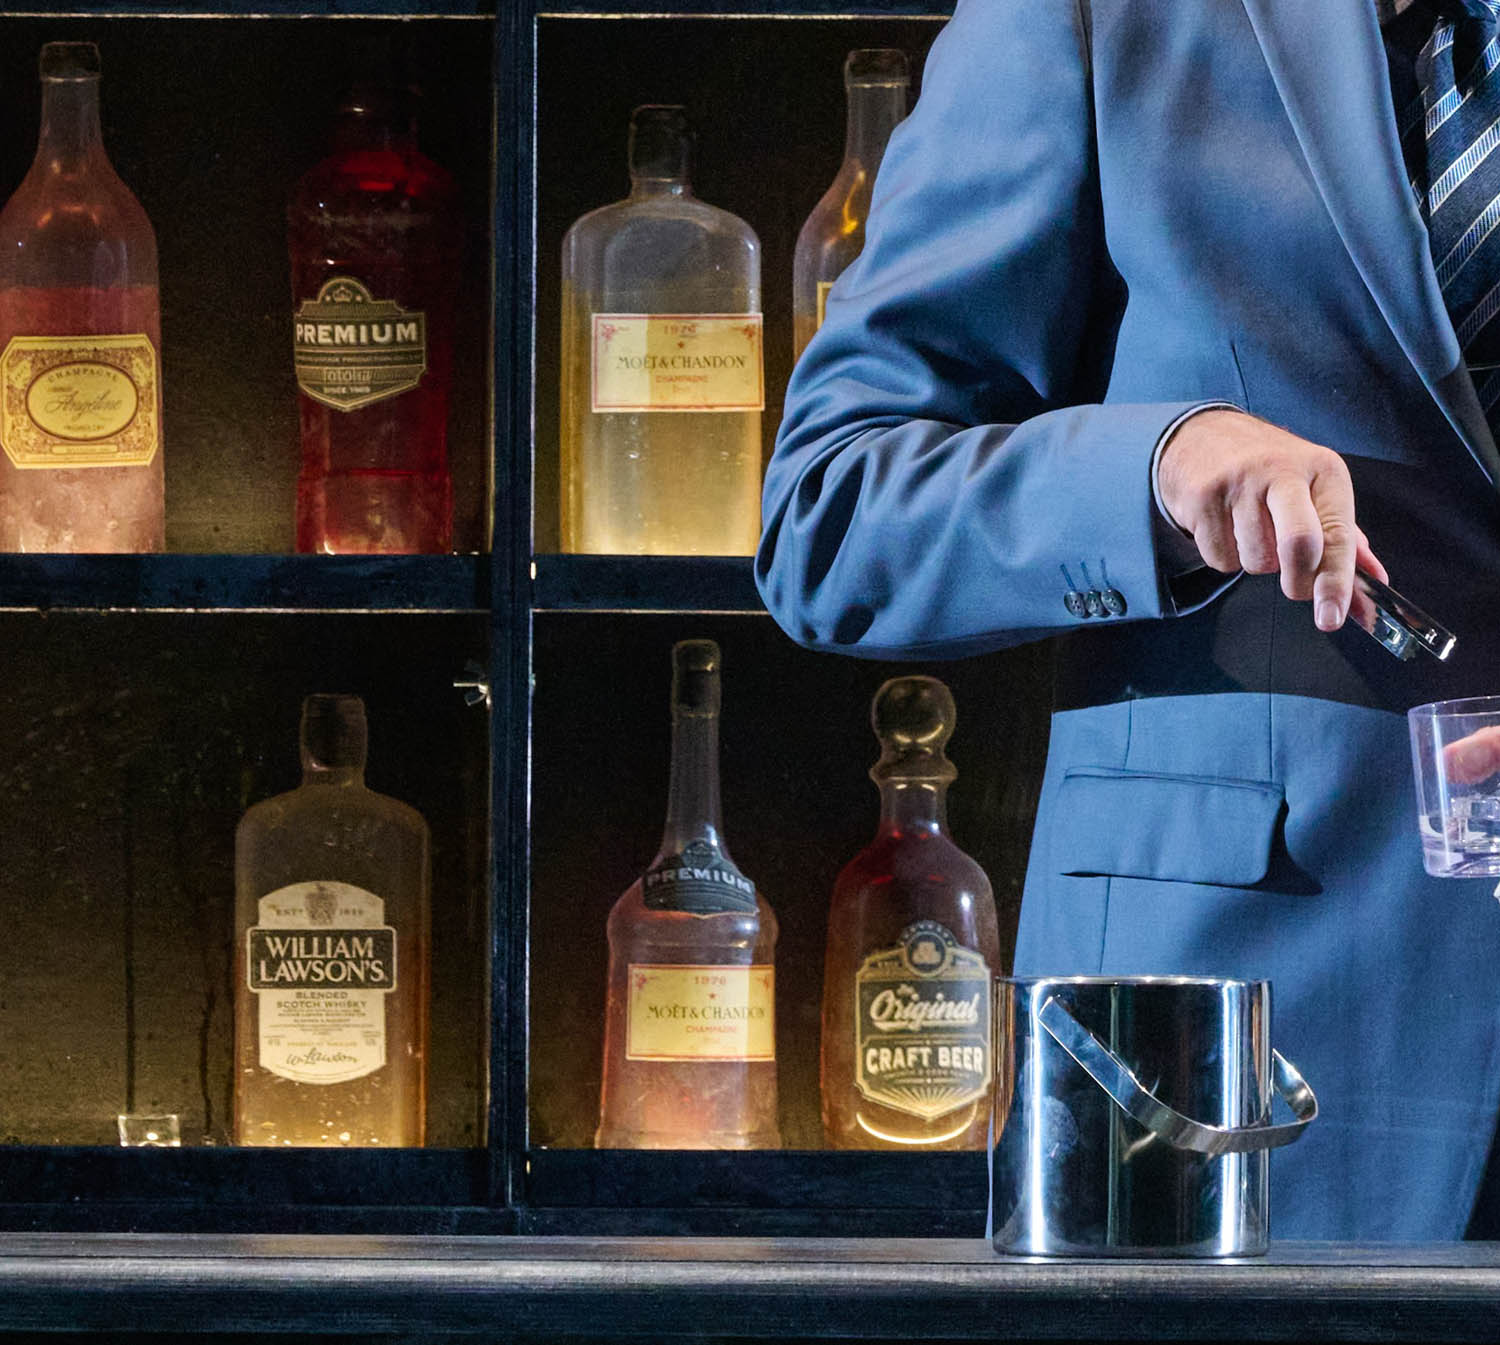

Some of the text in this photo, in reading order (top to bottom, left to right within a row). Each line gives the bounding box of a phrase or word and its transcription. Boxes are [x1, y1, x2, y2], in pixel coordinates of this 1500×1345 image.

[296, 323, 418, 345] PREMIUM
[671, 355, 746, 369] CHANDON
[48, 368, 118, 382] CHAMPAGNE
[647, 867, 752, 893] PREMIUM
[265, 936, 374, 958] WILLIAM
[260, 960, 386, 982] LAWSON'S
[701, 1006, 765, 1019] CHANDON
[870, 989, 980, 1031] Original
[866, 1046, 933, 1075] CRAFT
[937, 1046, 984, 1074] BEER
